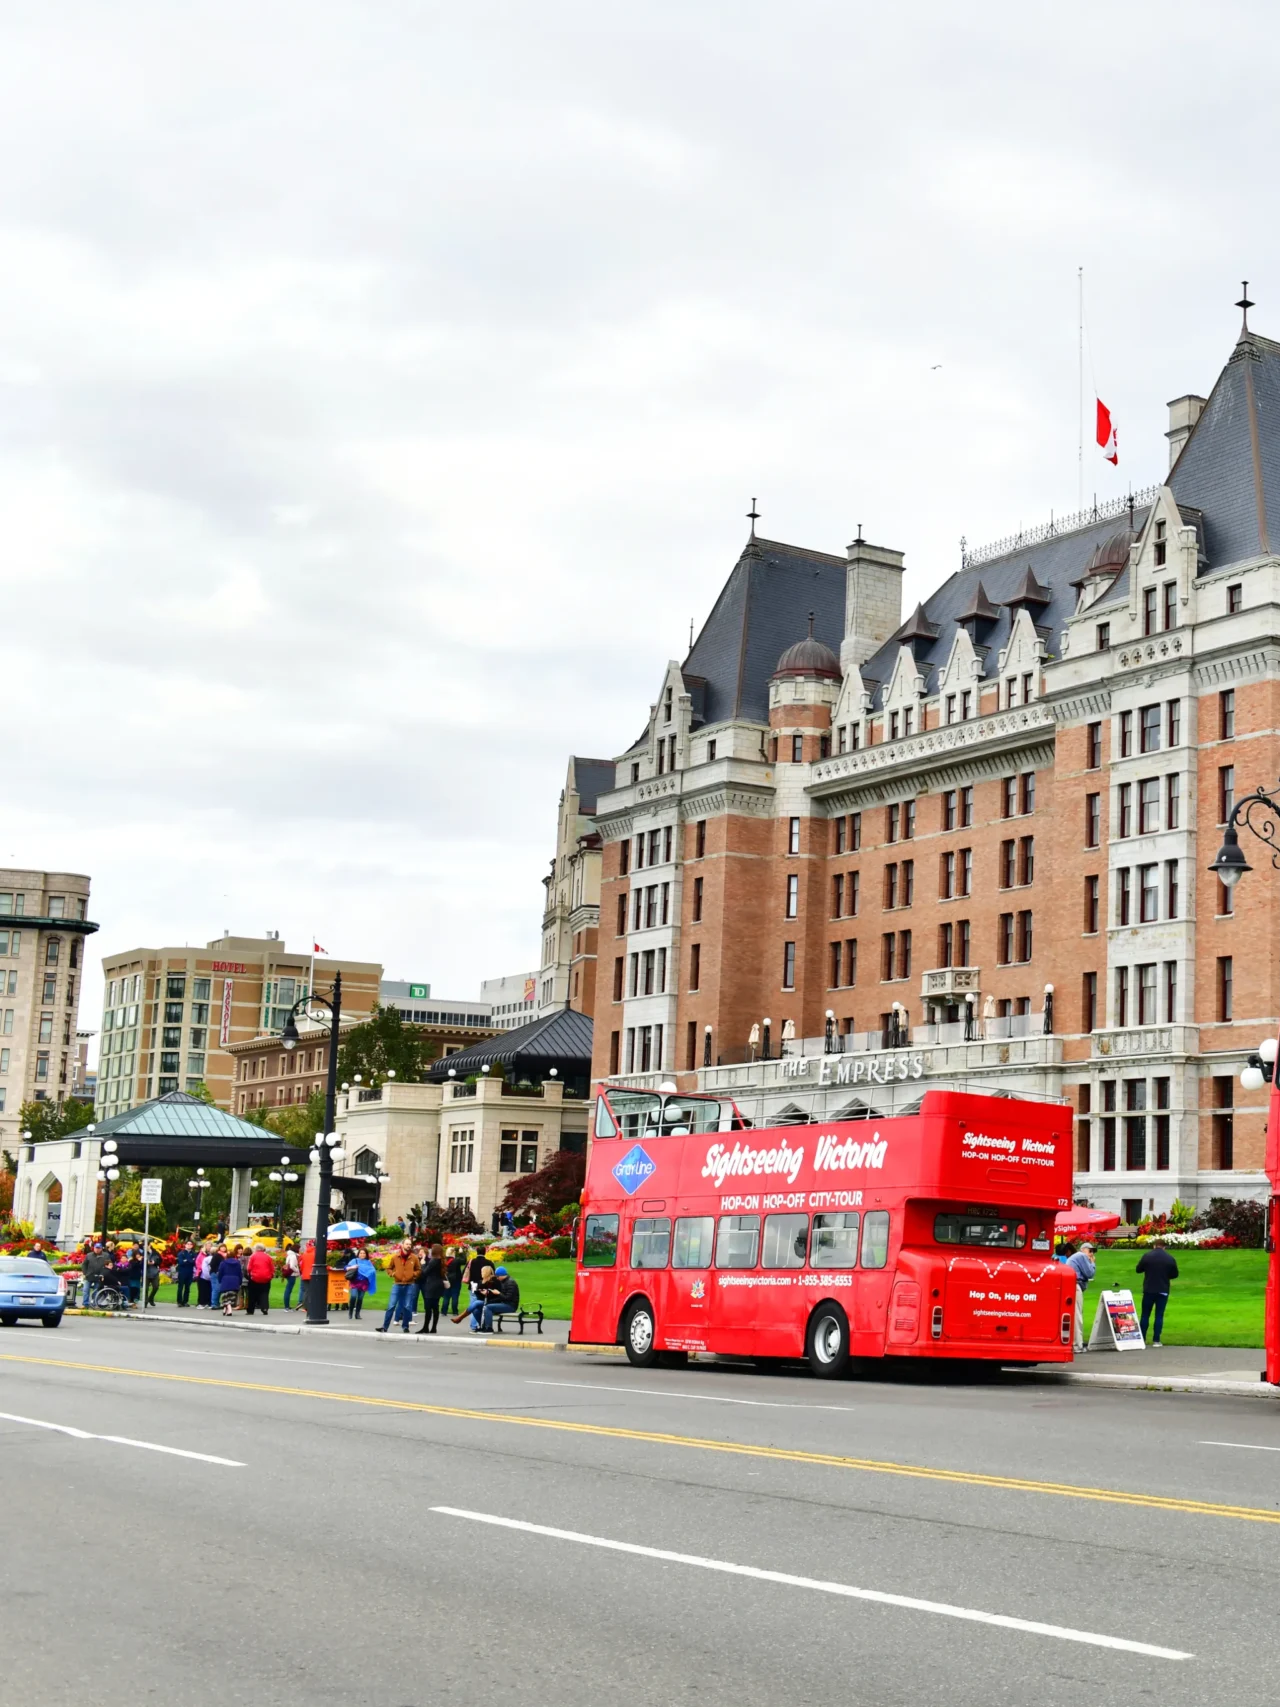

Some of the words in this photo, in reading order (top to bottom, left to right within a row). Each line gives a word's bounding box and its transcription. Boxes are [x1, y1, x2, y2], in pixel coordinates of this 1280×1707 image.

[212, 961, 246, 973] HOTEL
[412, 987, 425, 996] TD
[222, 982, 232, 1043] MAGNOLIA
[780, 1060, 808, 1076] THE
[818, 1056, 923, 1086] EMPRESS
[962, 1132, 1016, 1153] Sightseeing
[1022, 1138, 1055, 1154] Victoria
[701, 1138, 804, 1188] Sightseeing
[813, 1132, 888, 1171] Victoria
[962, 1151, 989, 1160] HOP-ON
[991, 1154, 1019, 1163] HOP-OFF
[1022, 1157, 1055, 1167] CITY-TOUR
[721, 1195, 759, 1210] HOP-ON
[763, 1193, 806, 1209] HOP-OFF
[808, 1191, 862, 1207] CITY-TOUR
[1058, 1199, 1068, 1207] 172
[718, 1275, 791, 1288] sightseeingvictoria.com
[798, 1275, 852, 1287] 1-855-385-6553
[969, 1291, 985, 1300] Hop
[988, 1292, 1001, 1301] On,
[1004, 1293, 1020, 1302] Hop
[973, 1309, 1031, 1318] sightseeingvictoria.com
